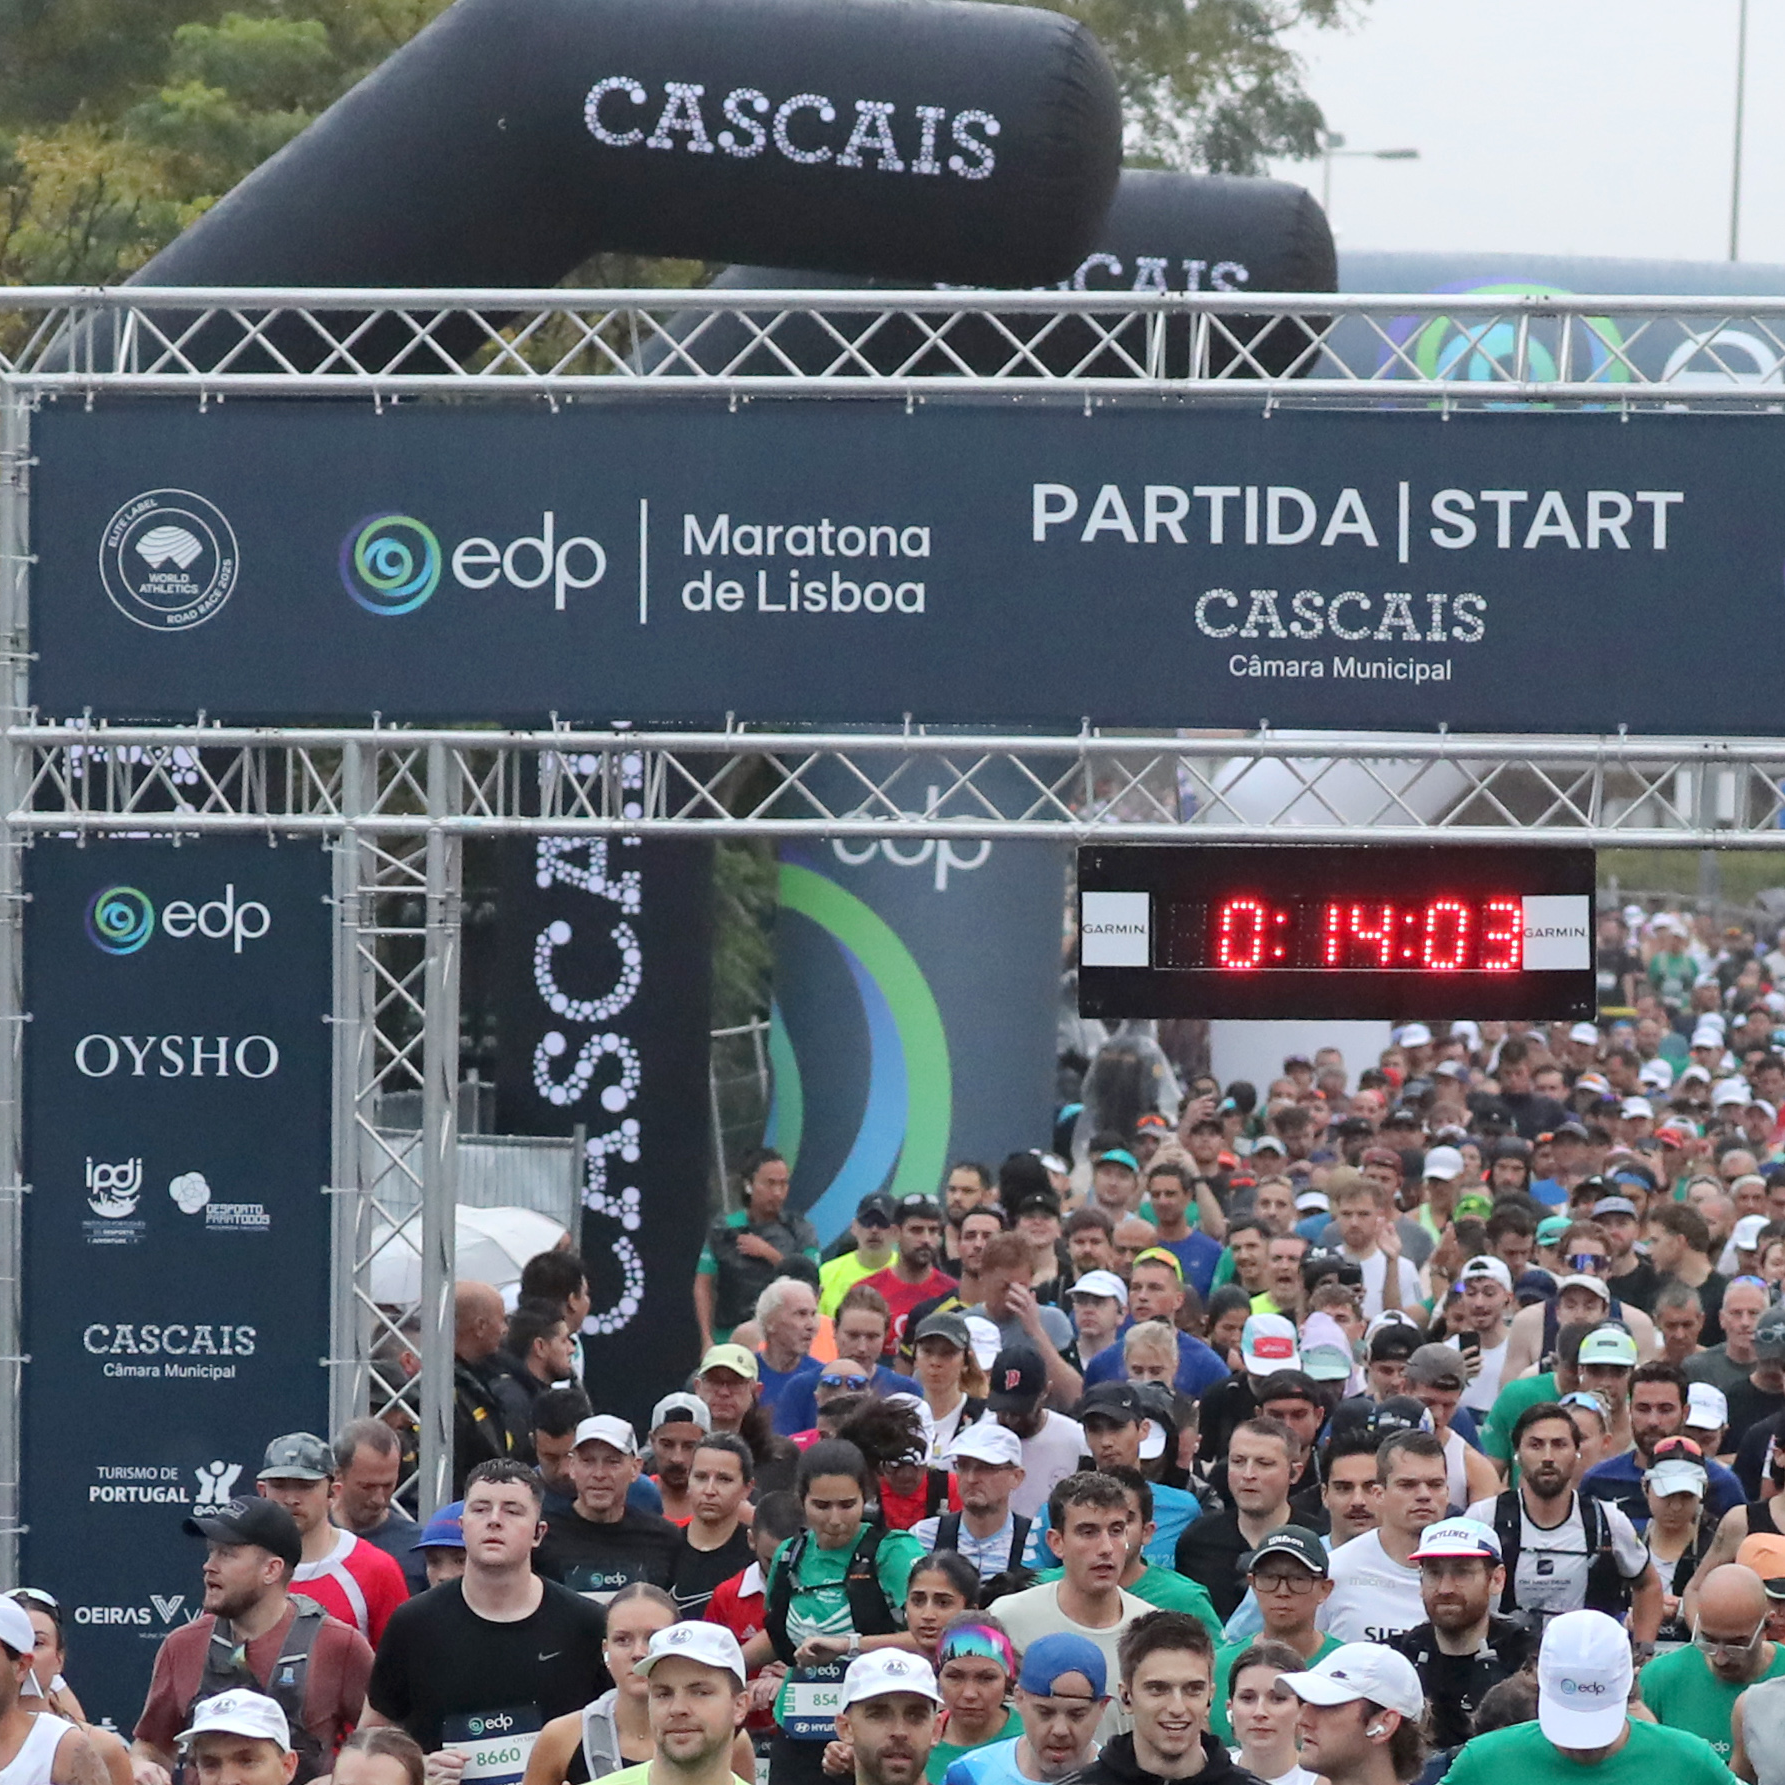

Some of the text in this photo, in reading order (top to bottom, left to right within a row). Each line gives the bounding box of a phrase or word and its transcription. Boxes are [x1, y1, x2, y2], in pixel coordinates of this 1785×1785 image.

[584, 76, 1001, 180] CASCAIS
[108, 499, 158, 548] ELITE LABEL
[1032, 484, 1684, 550] PARTIDA START
[682, 514, 931, 557] Maratona
[451, 511, 607, 610] edp
[139, 584, 198, 594] ATHLETICS
[149, 574, 189, 583] WORLD
[166, 558, 232, 623] ROAD RACE 2025
[682, 569, 926, 612] de Lisboa
[1195, 588, 1487, 642] CASCAIS
[1228, 654, 1452, 685] Câmara Municipal
[162, 883, 271, 953] edp
[1082, 924, 1147, 934] GARMIN
[1523, 927, 1587, 938] GARMIN
[74, 1034, 279, 1078] OYSHO
[206, 1204, 263, 1214] DESPORTO
[83, 1324, 256, 1355] CASCAIS
[103, 1362, 236, 1380] Câmara Municipal
[97, 1466, 178, 1480] TURISMO DE
[89, 1486, 189, 1503] PORTUGAL
[605, 1570, 627, 1586] edp
[75, 1607, 151, 1625] OEIRAS
[818, 1663, 841, 1677] edp
[1577, 1679, 1606, 1697] edp
[485, 1712, 514, 1733] edp
[477, 1746, 522, 1767] 8660
